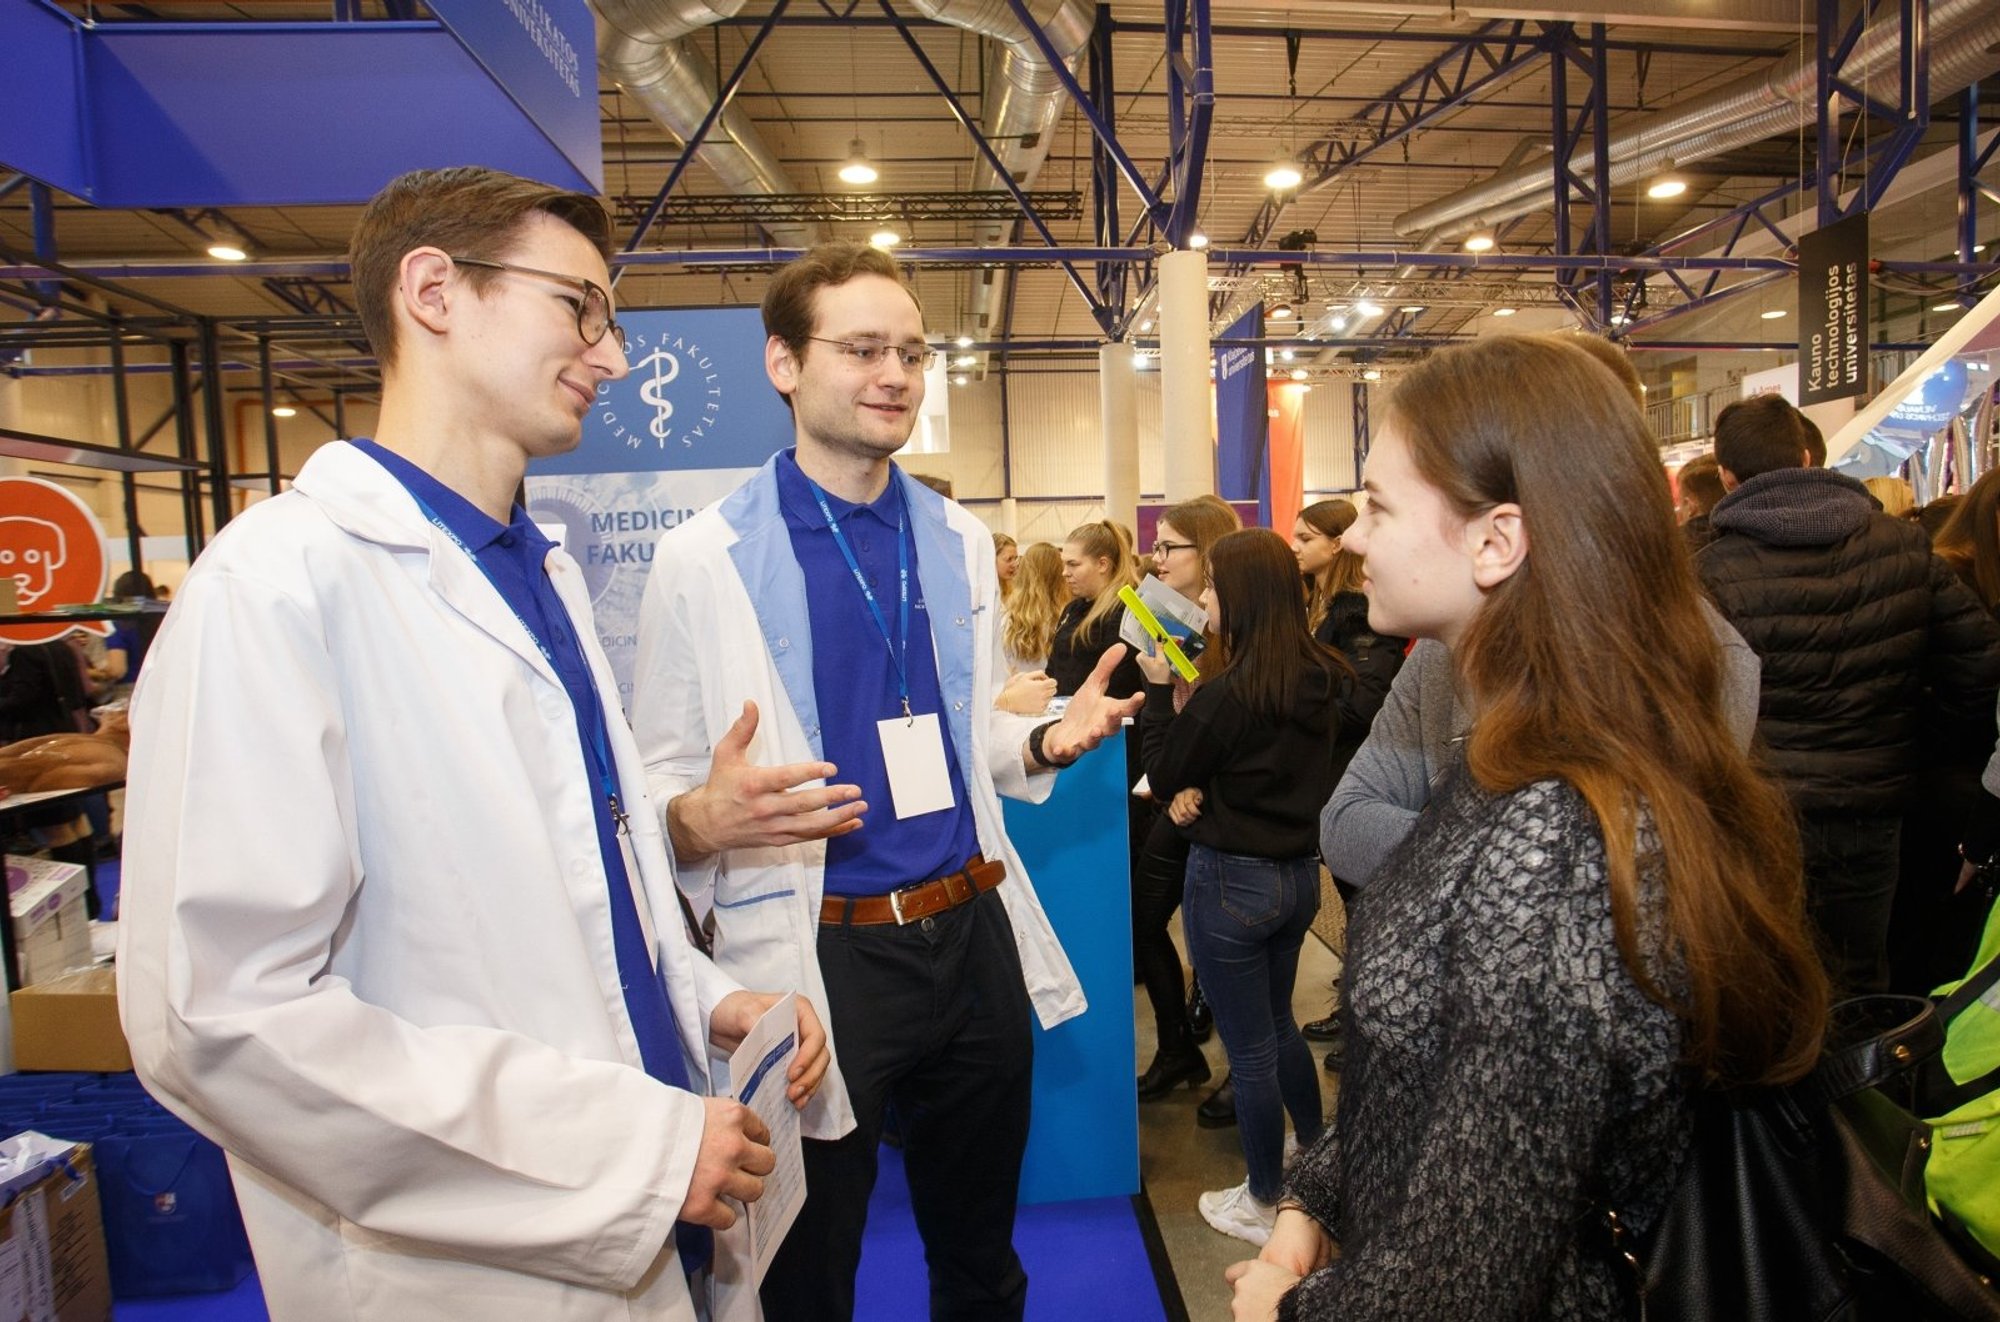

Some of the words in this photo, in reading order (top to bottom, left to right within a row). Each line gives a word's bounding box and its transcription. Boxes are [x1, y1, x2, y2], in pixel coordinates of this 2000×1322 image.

[503, 0, 580, 98] NIVERSITETAS
[525, 0, 579, 72] EIKATOS
[1808, 333, 1822, 392] Kauno
[1826, 264, 1843, 389] technologijos
[1843, 261, 1858, 384] universitetas
[597, 334, 647, 449] MEDICOS
[661, 333, 721, 448] FAKULTETAS
